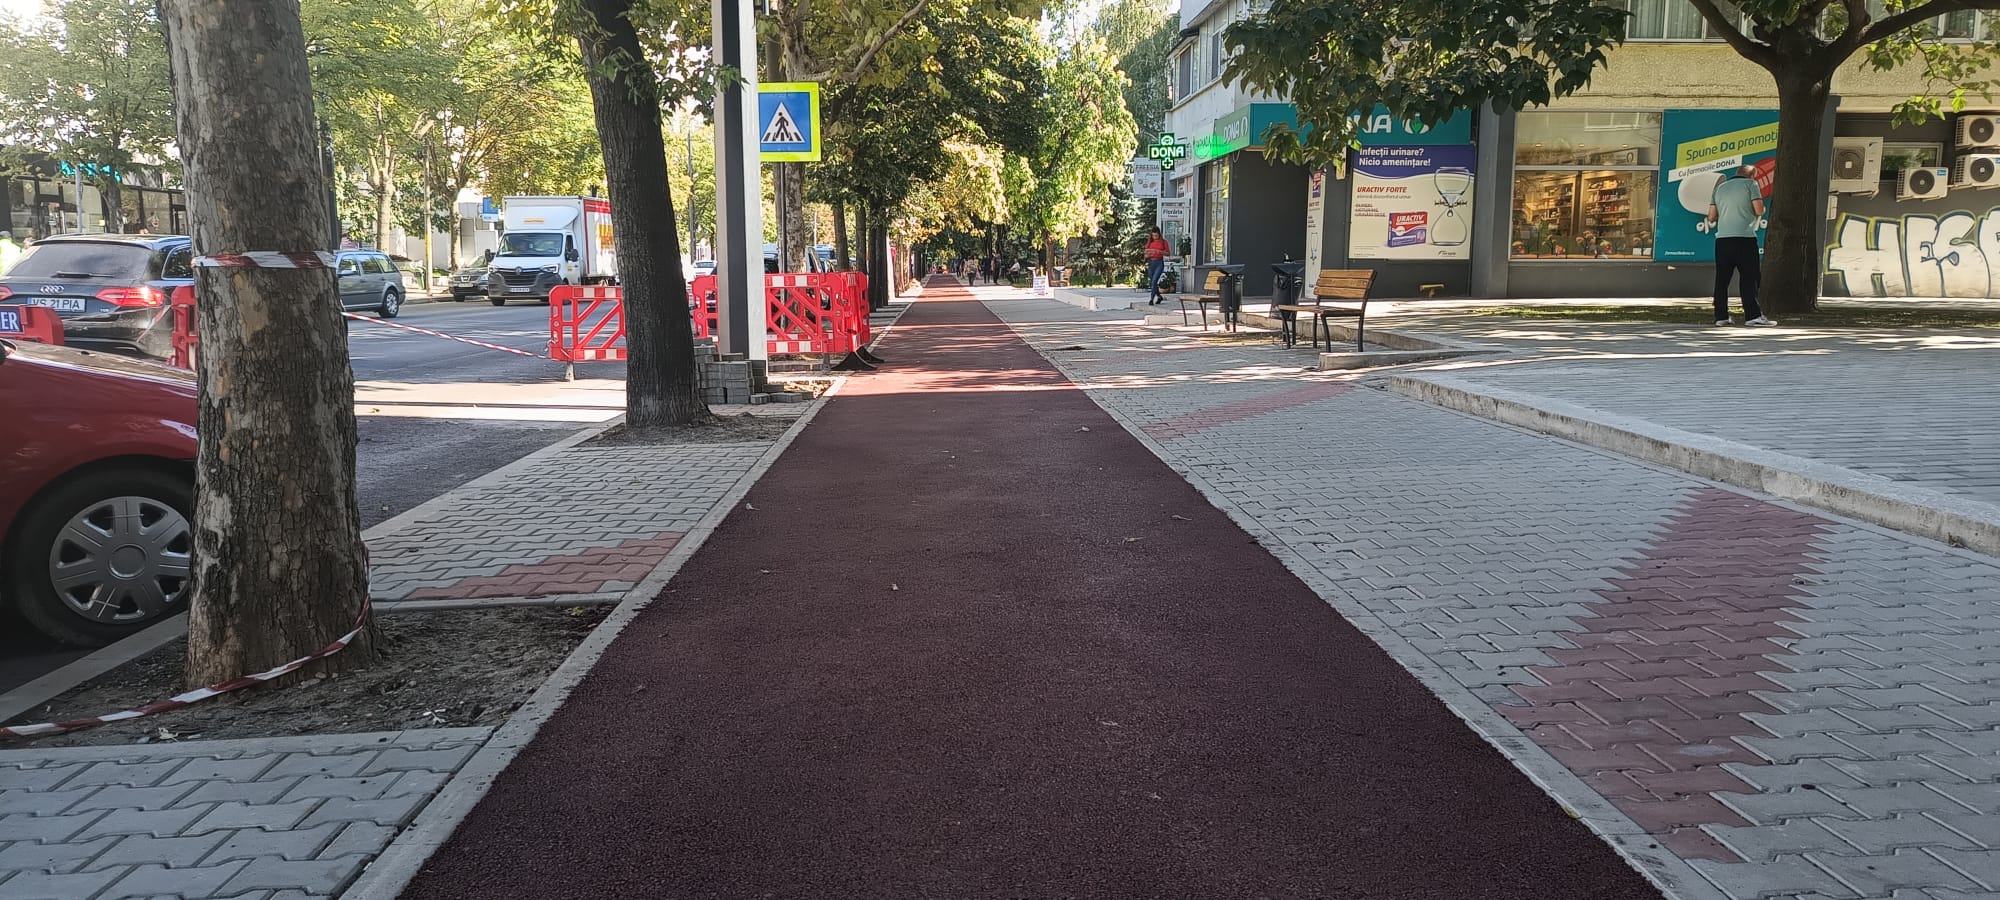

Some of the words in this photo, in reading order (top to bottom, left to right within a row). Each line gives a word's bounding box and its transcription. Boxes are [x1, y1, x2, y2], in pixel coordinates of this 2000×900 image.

[1224, 120, 1240, 144] DONA
[1150, 146, 1184, 158] DONA
[1359, 146, 1389, 158] Infecții
[1390, 147, 1424, 156] urinare?
[1686, 145, 1718, 161] Spune
[1720, 141, 1736, 153] Da
[1358, 157, 1381, 166] Nicio
[1381, 157, 1431, 168] amenințare!
[1678, 170, 1687, 178] Cu
[1686, 164, 1716, 176] farmaciile
[1716, 159, 1736, 169] DONA
[1396, 214, 1425, 223] URACTIV
[49, 299, 60, 309] 21
[62, 300, 80, 309] PIA
